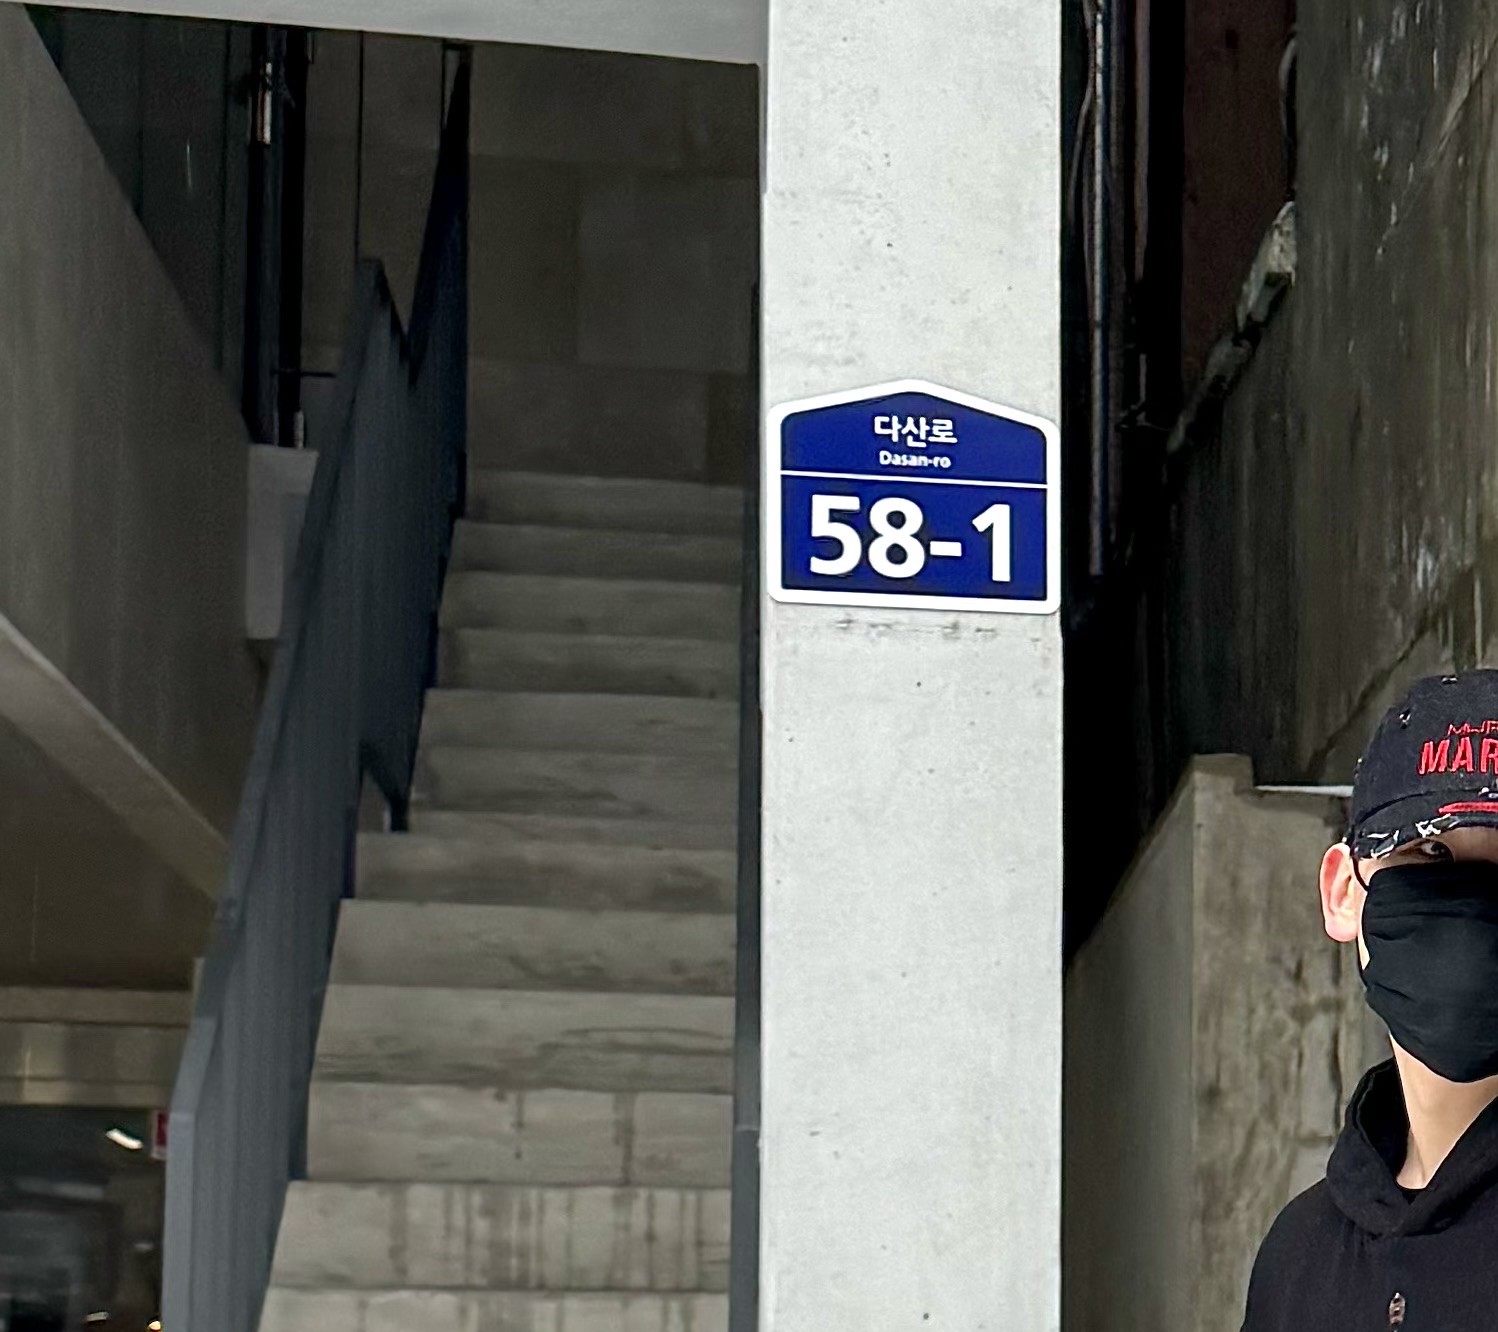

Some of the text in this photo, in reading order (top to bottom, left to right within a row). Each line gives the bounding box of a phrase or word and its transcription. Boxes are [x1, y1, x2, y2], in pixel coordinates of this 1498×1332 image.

[874, 415, 958, 448] 다산로
[879, 450, 952, 469] Dasan-ro
[809, 493, 1011, 583] 58-1
